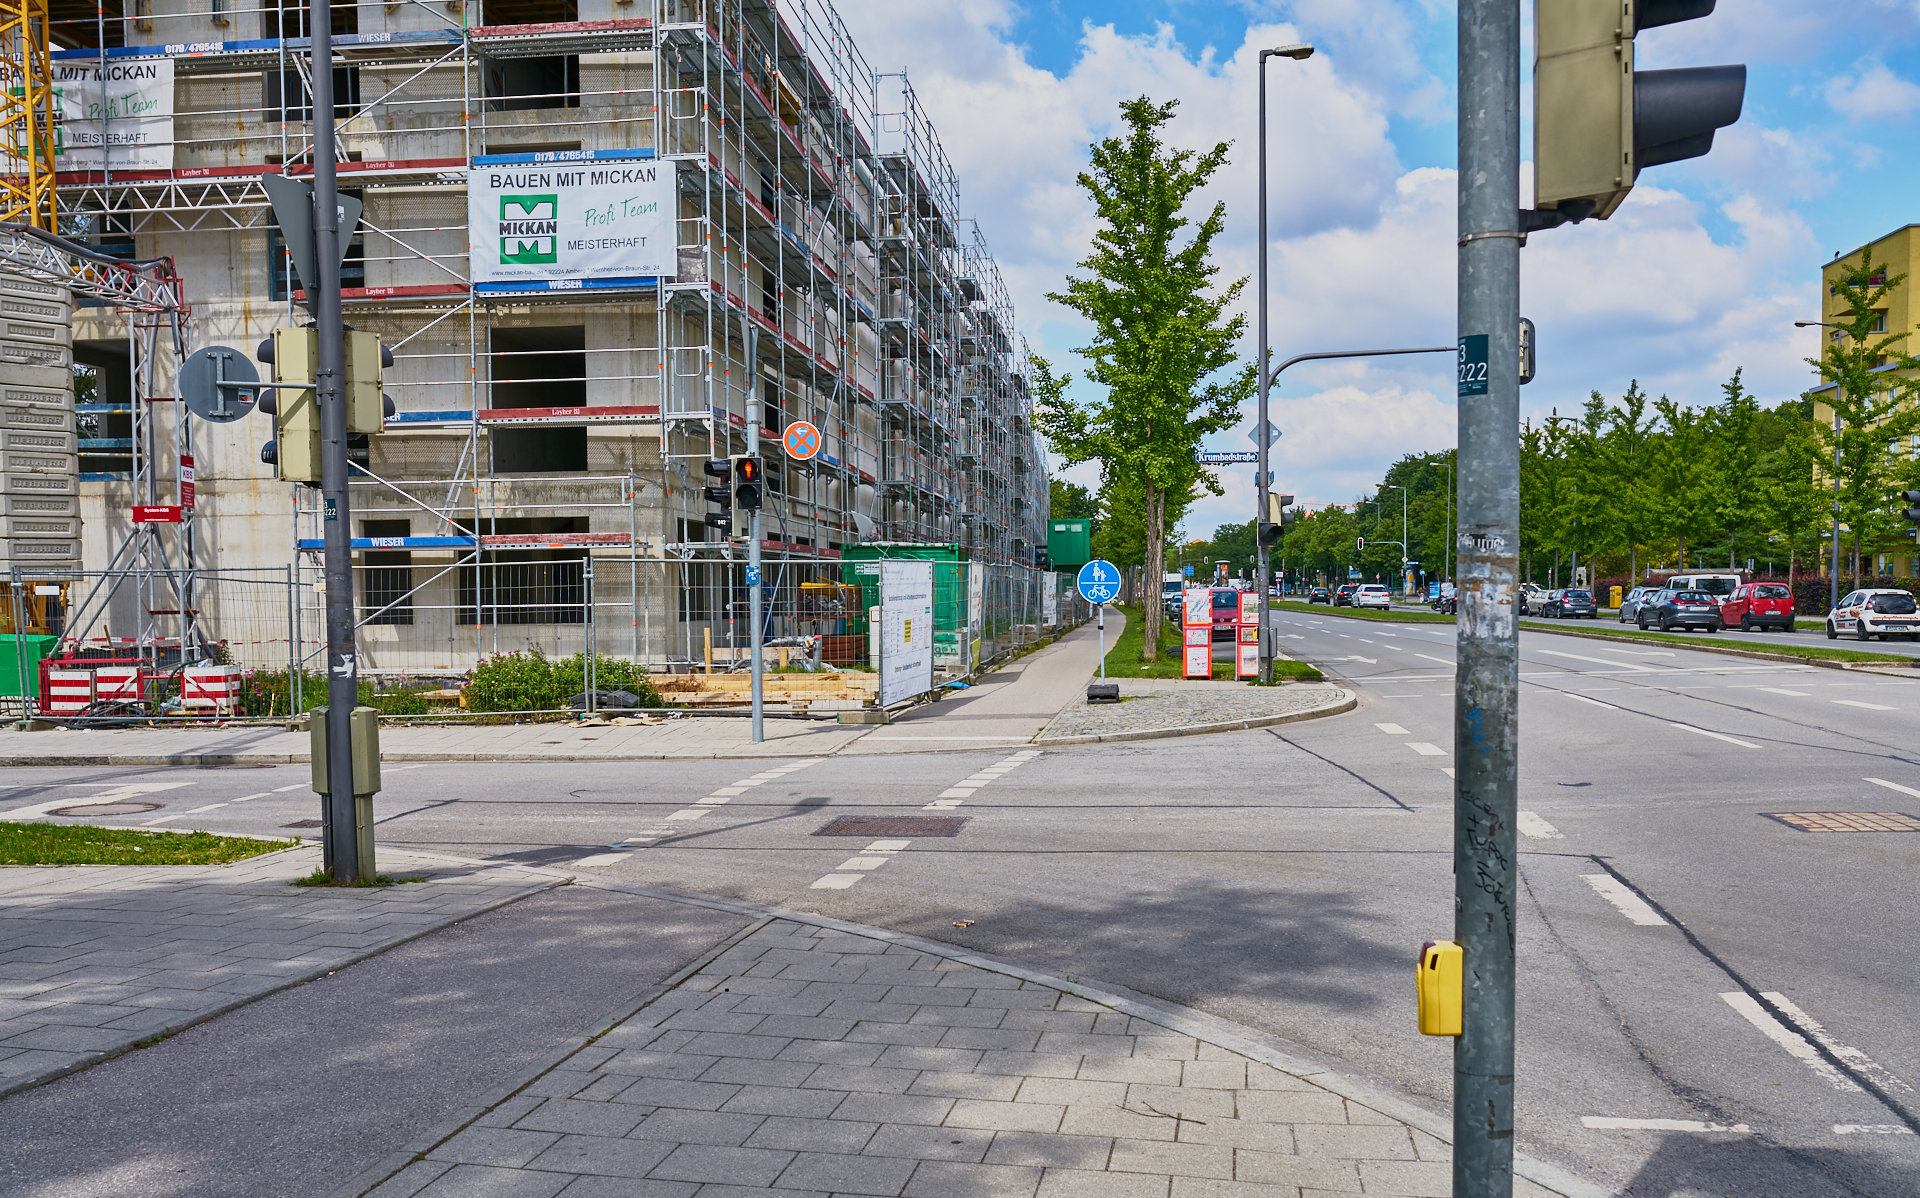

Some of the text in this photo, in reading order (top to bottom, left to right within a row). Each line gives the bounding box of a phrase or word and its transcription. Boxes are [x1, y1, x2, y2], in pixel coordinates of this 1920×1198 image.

[358, 33, 390, 43] WIESER
[59, 66, 89, 81] MIT
[94, 65, 156, 81] MICKAN
[121, 92, 157, 114] Team
[534, 151, 595, 161] 0179/4765415
[490, 167, 656, 188] BAUEN MIT MICKAN
[585, 196, 657, 227] Profi Team
[499, 221, 557, 236] MICKAN
[568, 237, 647, 250] MEISTERHAFT
[548, 280, 582, 289] WIESER
[4, 302, 59, 316] LIEBHERR
[10, 436, 64, 446] LIEBHERR
[1198, 452, 1256, 462] Krumbadstraße
[183, 470, 192, 479] KBS
[13, 479, 67, 488] LIEBHERR
[13, 500, 67, 510] LIEBHERR
[371, 537, 404, 547] WIESER
